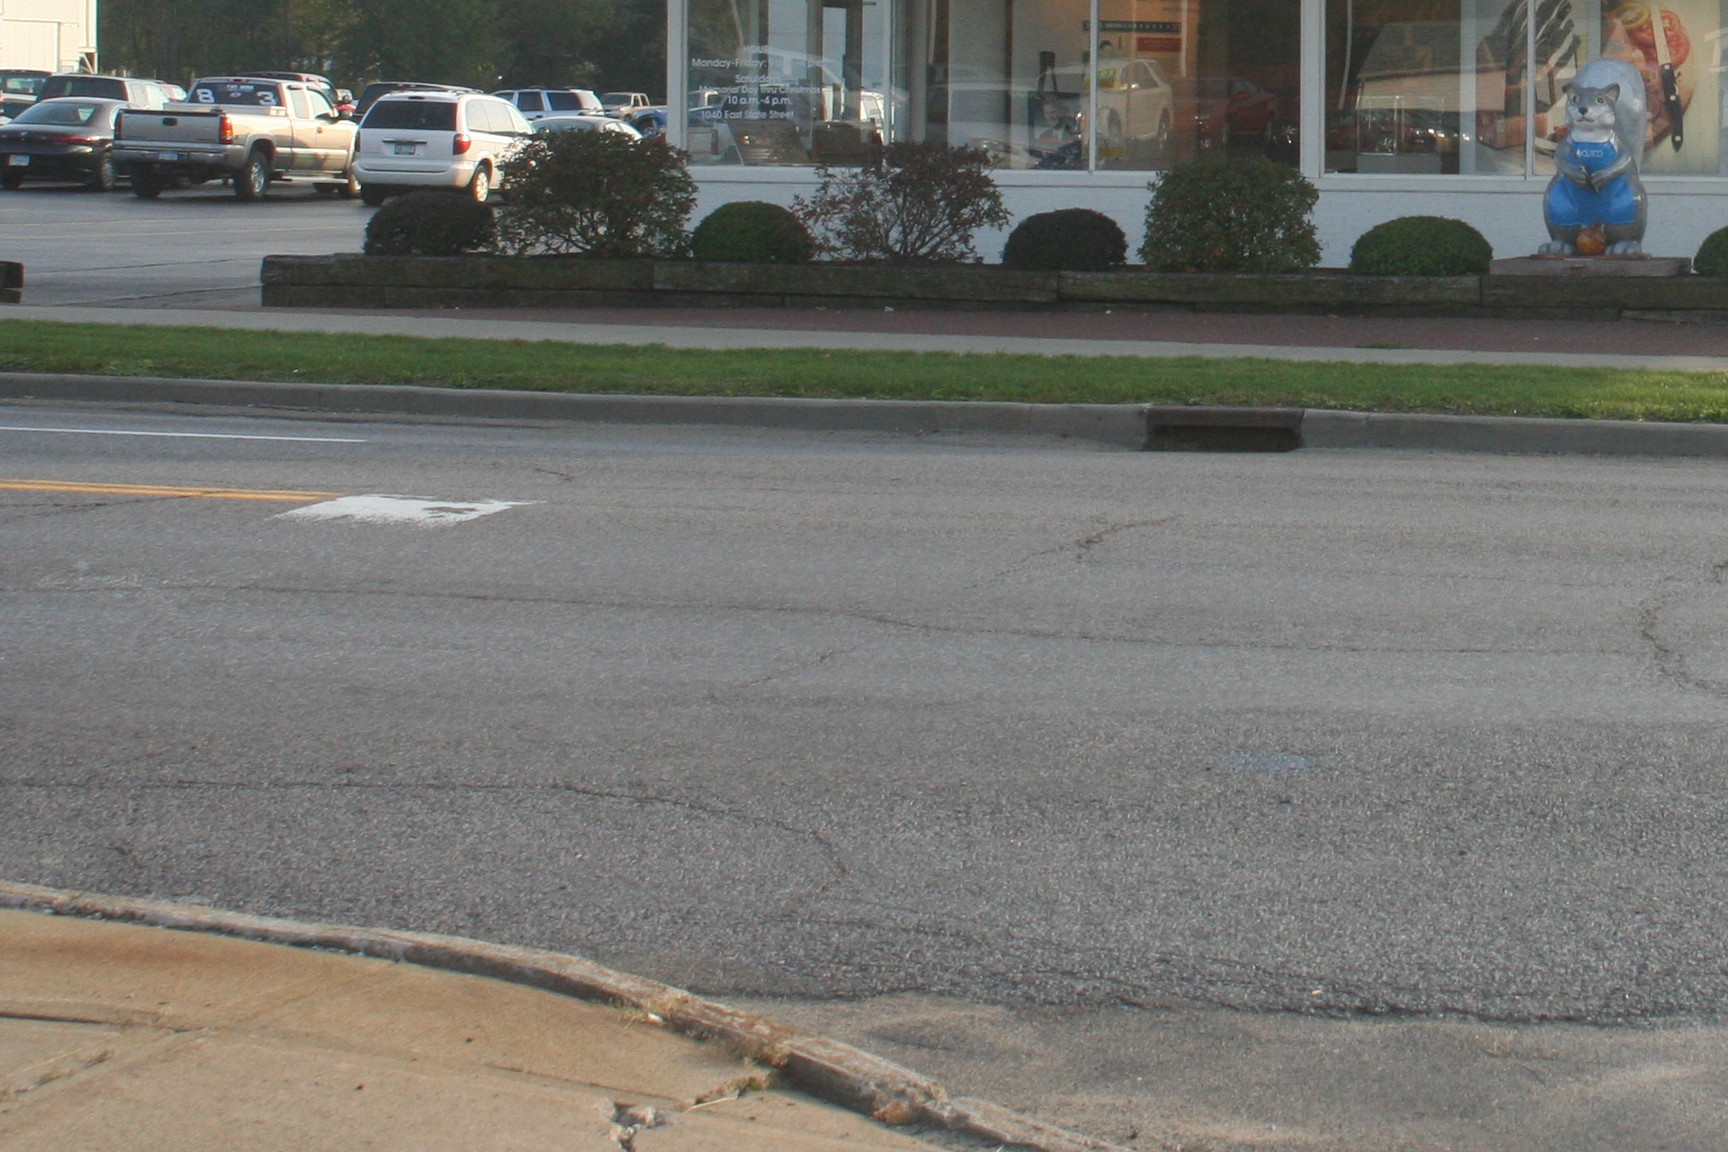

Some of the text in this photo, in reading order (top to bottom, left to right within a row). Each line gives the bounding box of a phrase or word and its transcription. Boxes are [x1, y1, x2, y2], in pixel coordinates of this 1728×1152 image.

[741, 85, 758, 96] Day
[197, 89, 215, 104] 8
[257, 91, 277, 106] 3
[728, 95, 738, 105] 10
[702, 110, 722, 119] 1040
[724, 110, 742, 119] East
[769, 110, 795, 119] Street
